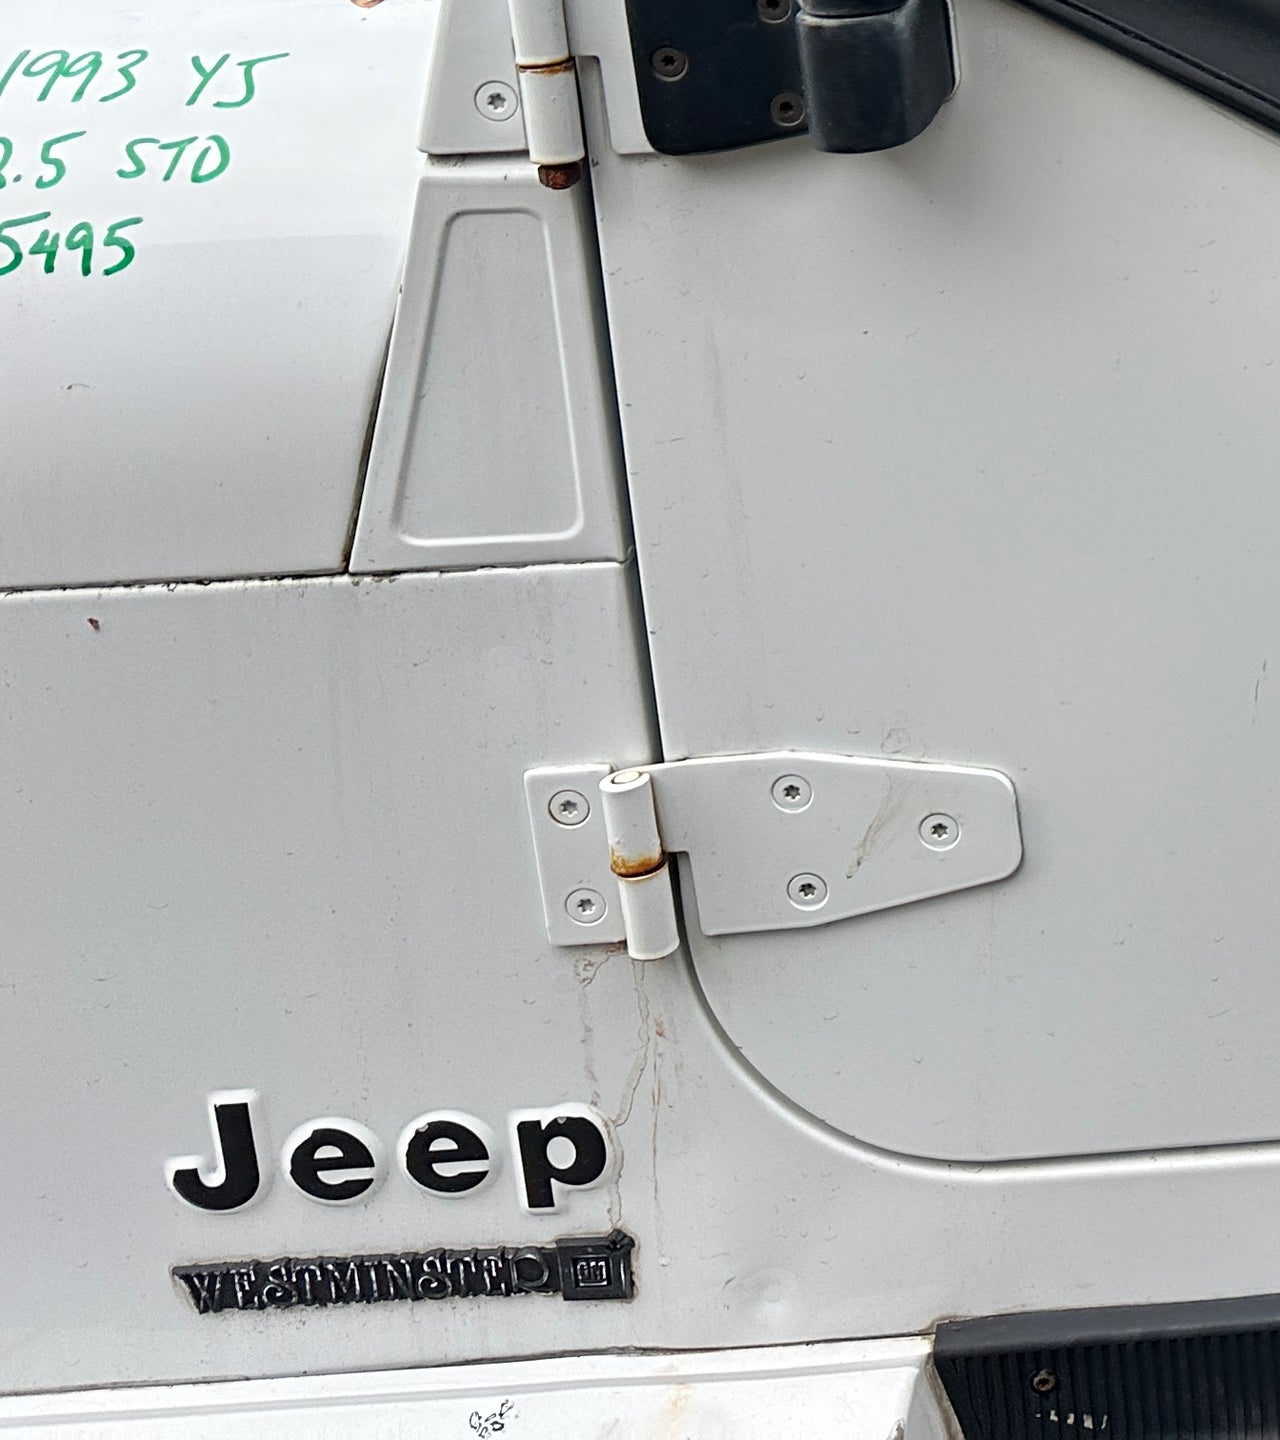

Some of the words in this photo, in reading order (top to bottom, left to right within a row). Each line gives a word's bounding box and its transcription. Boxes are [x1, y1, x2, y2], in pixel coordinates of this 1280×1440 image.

[0, 49, 149, 103] 1993
[185, 52, 290, 108] YJ
[116, 134, 231, 184] STD
[0, 211, 144, 277] 5495
[168, 1095, 611, 1213] Jeep
